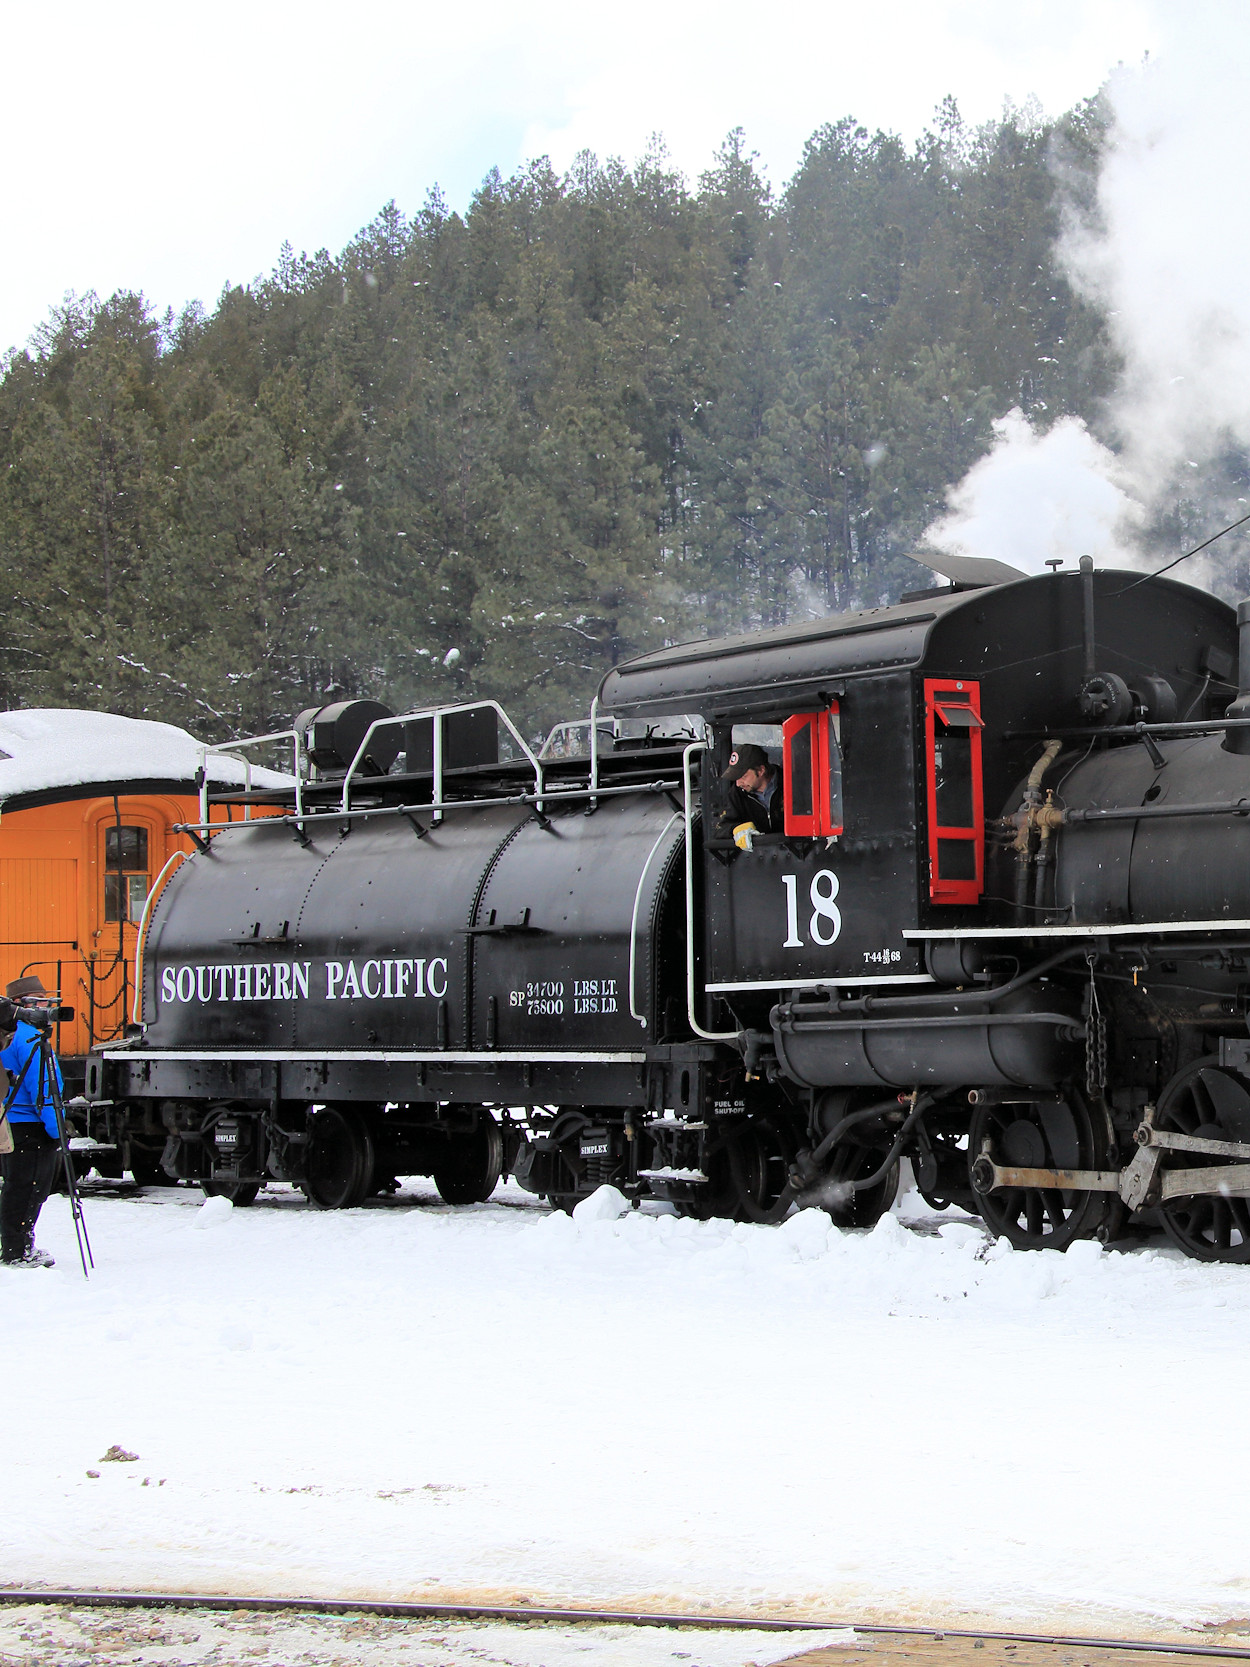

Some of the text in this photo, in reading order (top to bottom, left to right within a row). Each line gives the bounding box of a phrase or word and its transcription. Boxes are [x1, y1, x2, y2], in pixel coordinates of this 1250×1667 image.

[781, 869, 842, 948] 18
[890, 950, 901, 962] 68
[161, 957, 448, 1003] SOUTHERN PACIFIC
[509, 990, 525, 1007] SP
[526, 998, 564, 1015] 75800
[714, 1107, 745, 1115] SHUT-OFF
[580, 1144, 608, 1155] SIMPLEX
